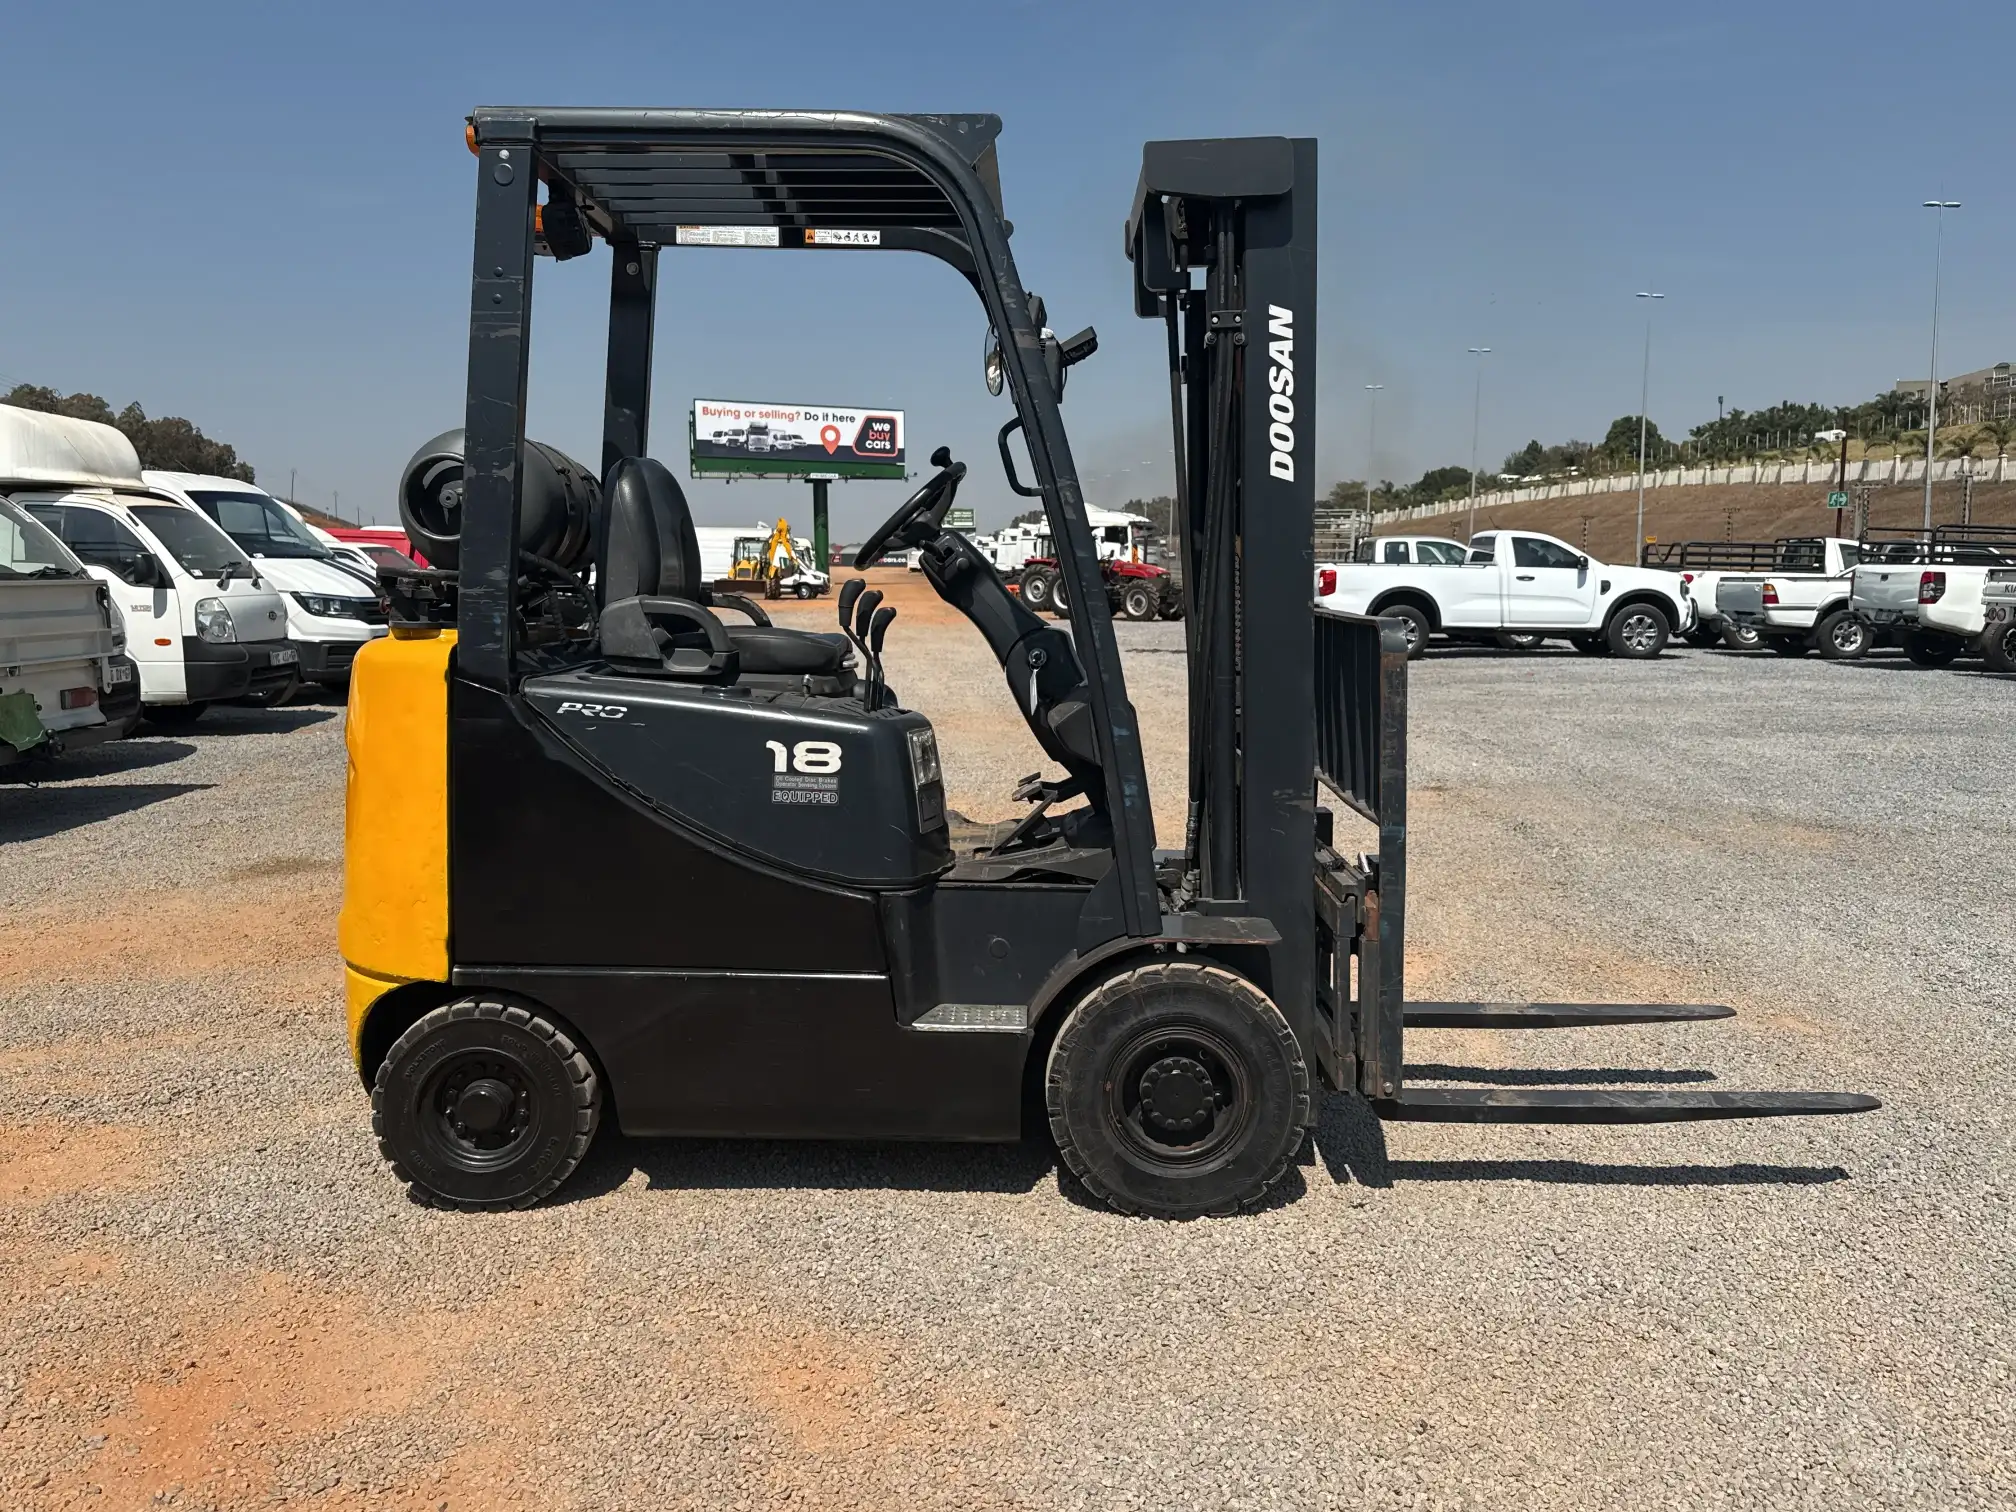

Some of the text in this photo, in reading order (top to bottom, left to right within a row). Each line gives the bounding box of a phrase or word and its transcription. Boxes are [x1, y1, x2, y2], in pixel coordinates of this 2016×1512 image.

[1269, 304, 1294, 482] DOOSAN
[702, 406, 856, 423] Buying or selling? Do it here
[872, 422, 891, 431] we
[869, 430, 890, 441] buy
[865, 440, 891, 449] cars
[556, 702, 628, 719] PRO
[766, 740, 842, 773] 18
[772, 790, 839, 804] EQUIPPED
